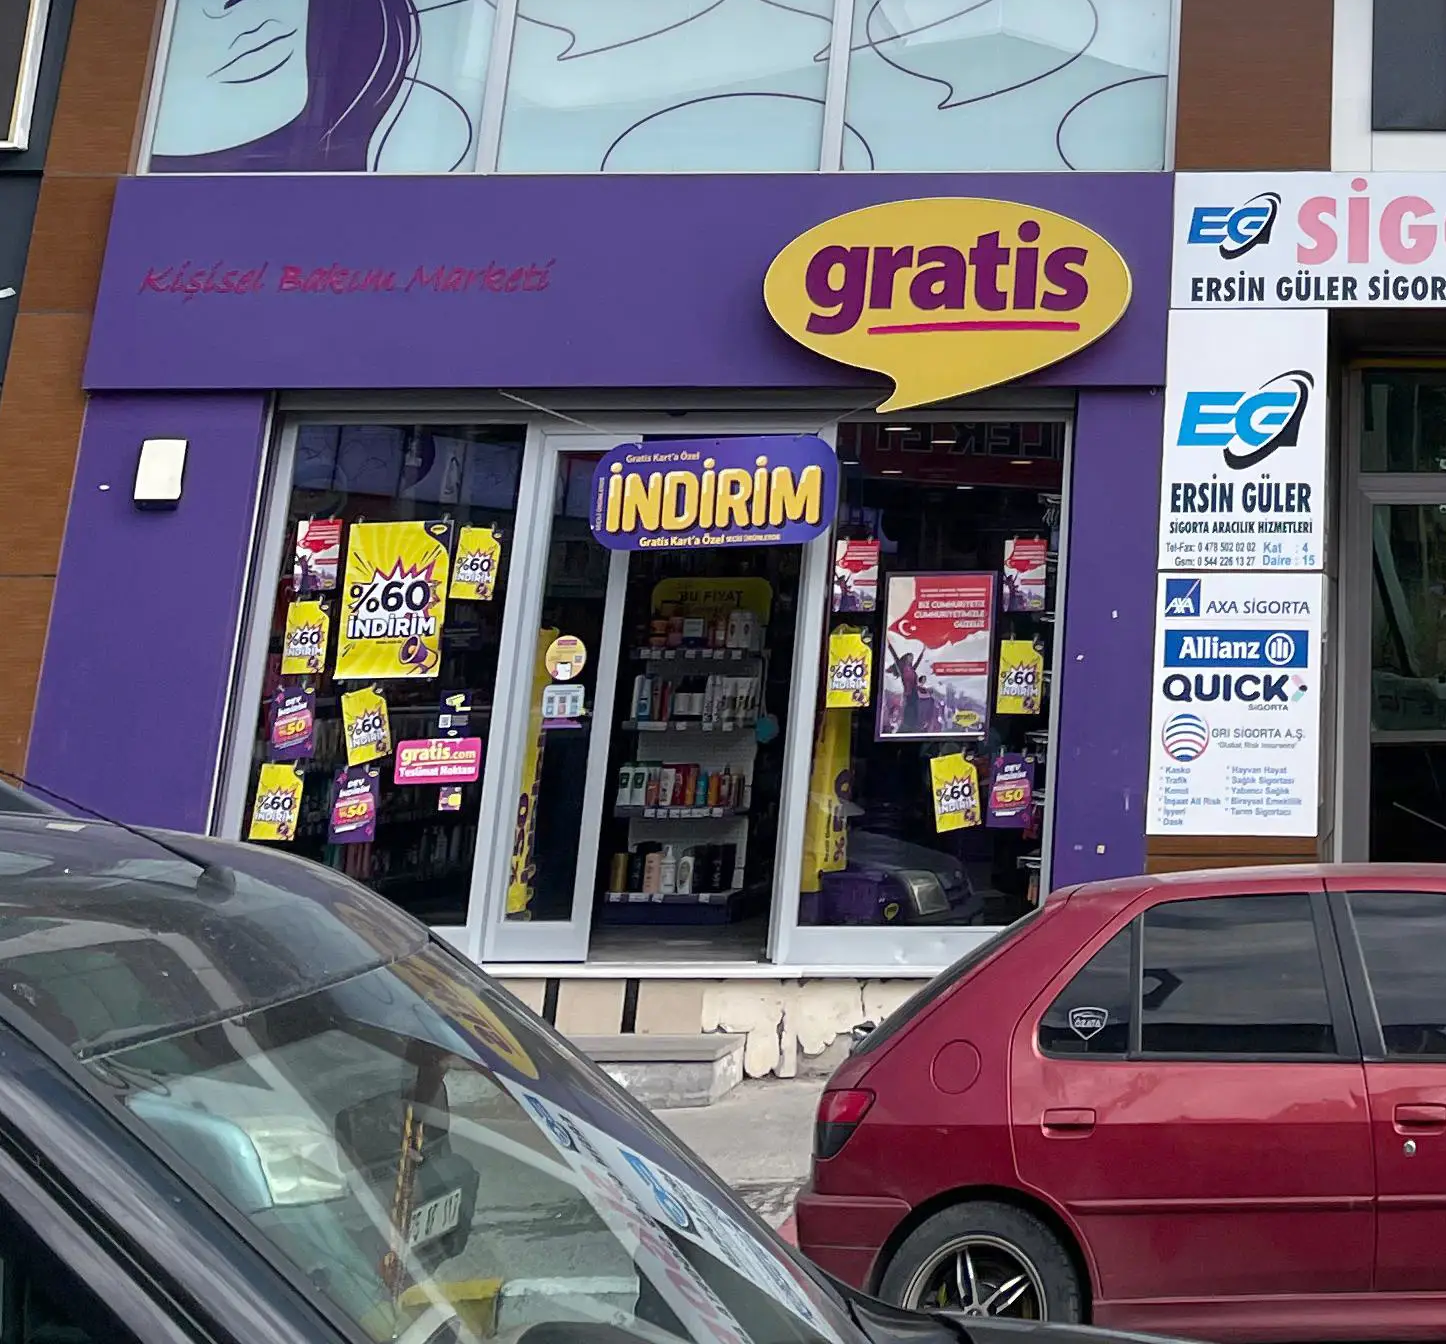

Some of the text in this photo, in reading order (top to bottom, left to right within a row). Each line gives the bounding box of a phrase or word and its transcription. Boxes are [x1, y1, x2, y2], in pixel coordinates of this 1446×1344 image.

[805, 219, 1090, 335] gratis
[1191, 271, 1264, 302] ERSİN
[1276, 270, 1358, 301] GÜLER
[606, 455, 822, 533] İNDİRİM
[1171, 474, 1311, 512] ERSİN GÜLER
[1169, 518, 1313, 533] SİGORTA ARACILIK HİZMETLERİ
[640, 537, 669, 547] Gratis
[349, 581, 431, 613] %60
[1206, 598, 1310, 614] AXA SİGORTA
[347, 614, 436, 638] İNDİRİM
[1179, 636, 1260, 659] Allianz
[1163, 674, 1290, 702] QUICK
